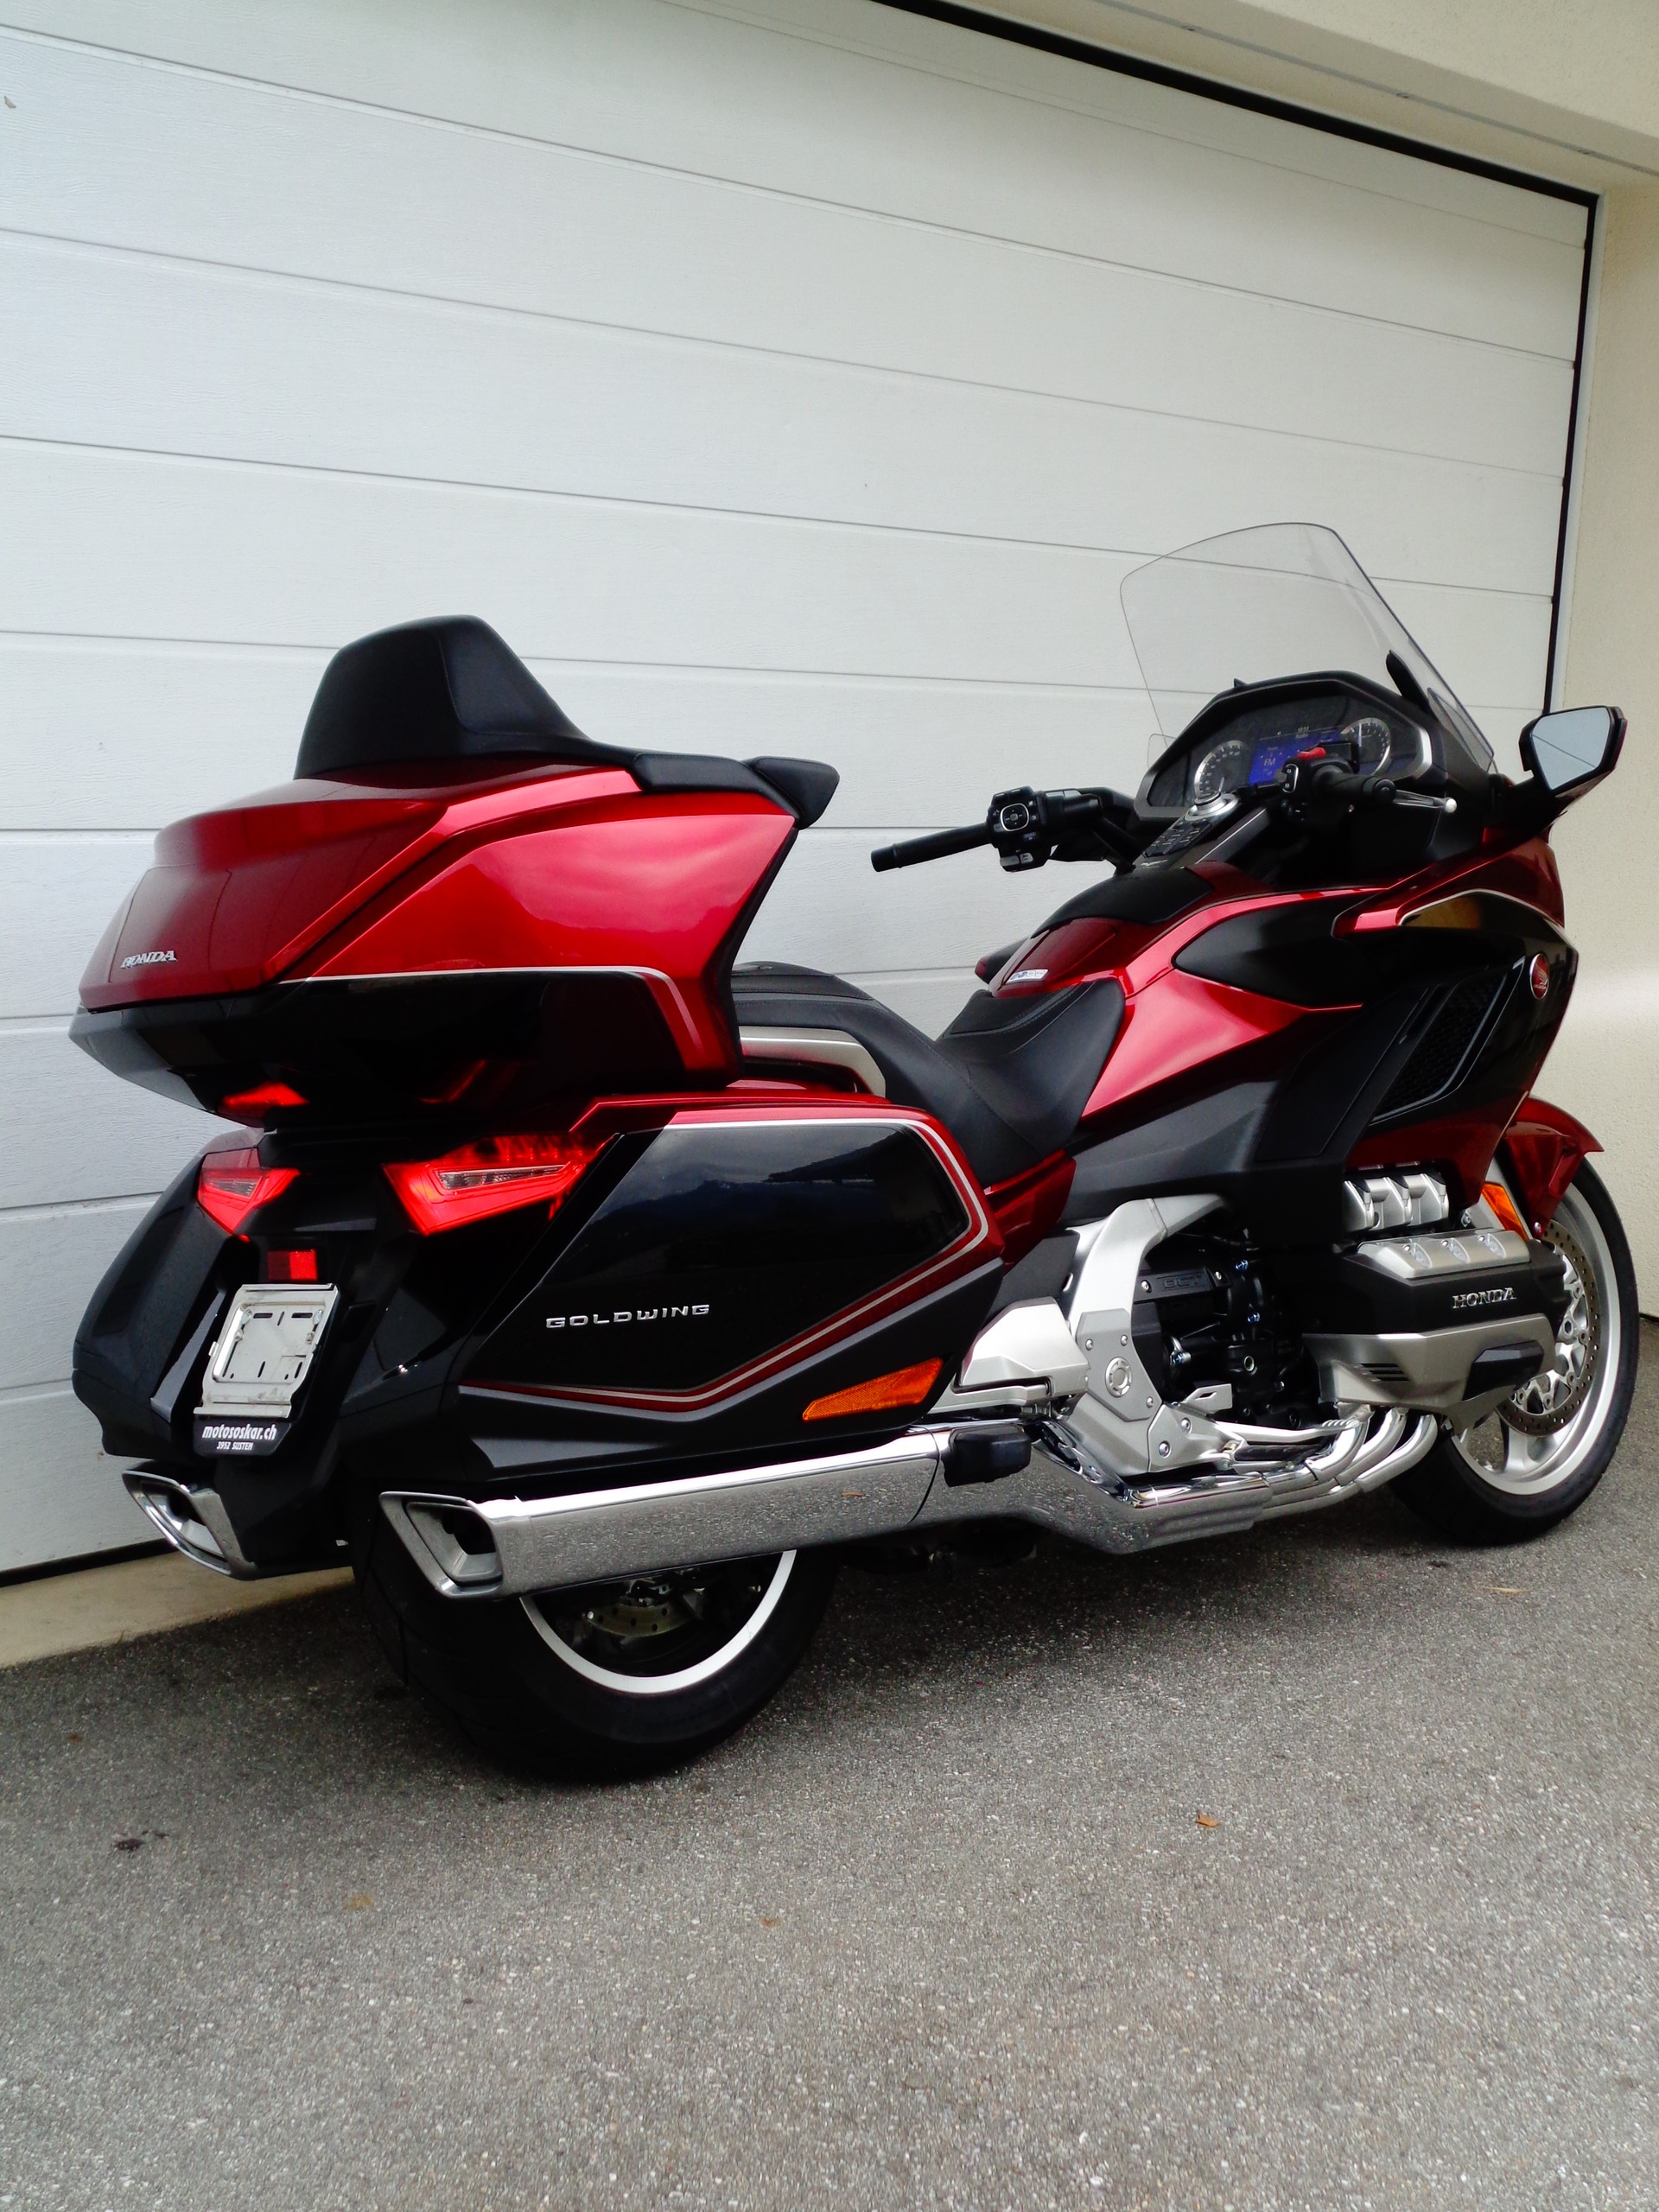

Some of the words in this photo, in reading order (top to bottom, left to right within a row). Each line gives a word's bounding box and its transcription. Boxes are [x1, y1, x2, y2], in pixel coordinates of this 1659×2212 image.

[121, 950, 177, 969] HONDA
[1452, 1287, 1517, 1309] HONDA
[545, 1304, 710, 1329] GOLDWING
[201, 1423, 277, 1440] motososkar.ch
